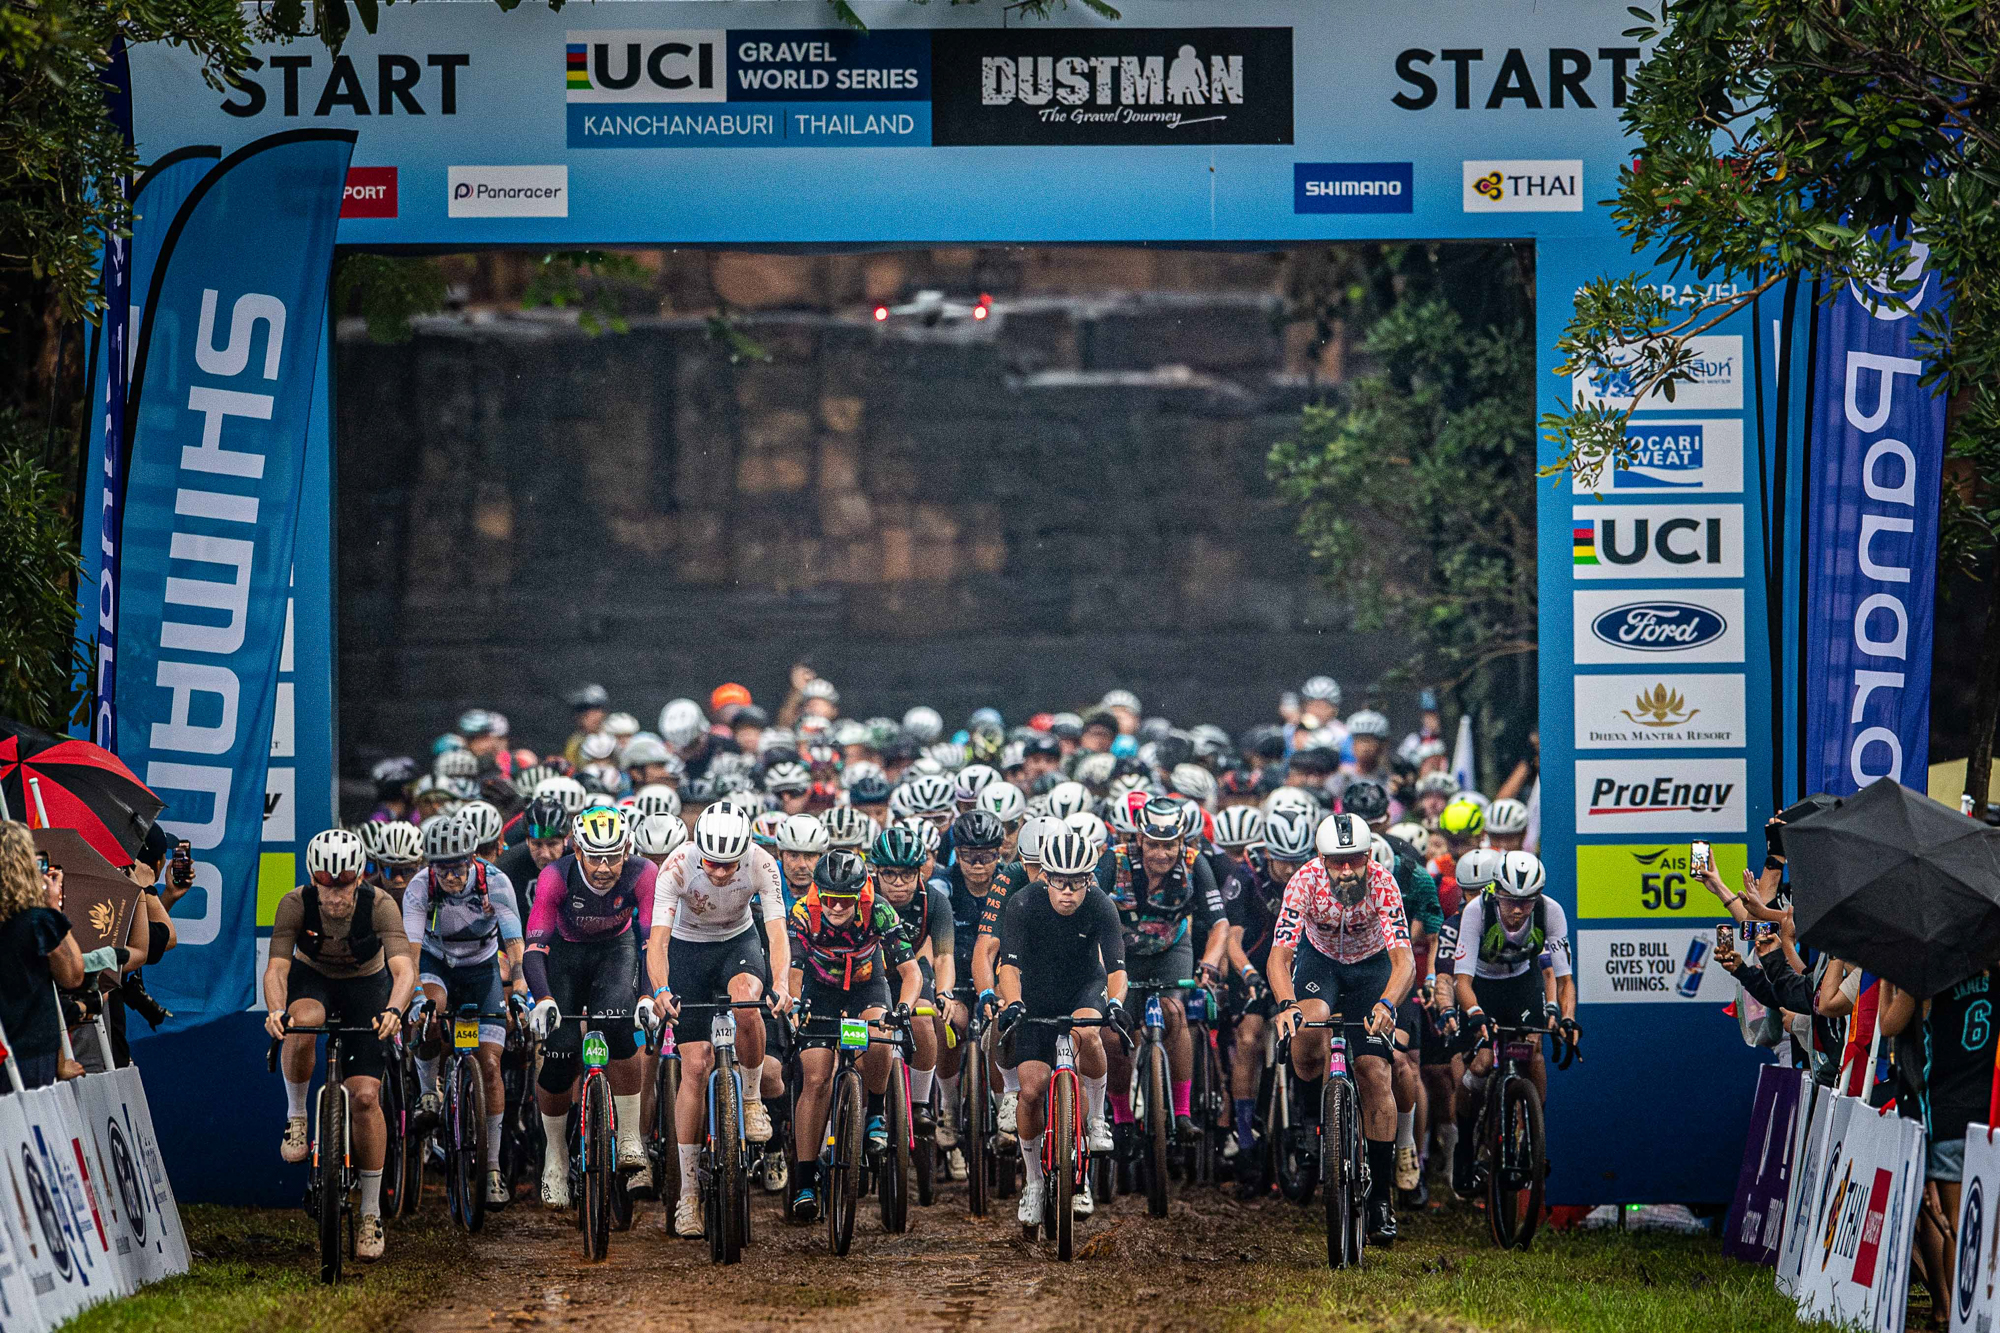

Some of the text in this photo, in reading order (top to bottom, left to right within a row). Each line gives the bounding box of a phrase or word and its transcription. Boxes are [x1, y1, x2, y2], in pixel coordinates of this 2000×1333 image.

[738, 42, 837, 63] GRAVEL
[594, 43, 713, 90] UCI
[220, 54, 470, 117] START
[737, 68, 918, 90] WORLD SERIES
[1391, 48, 1640, 110] START
[584, 115, 774, 136] KANCHANABURI
[795, 114, 914, 135] THAILAND
[1038, 106, 1182, 129] The Gravel Journey
[477, 183, 561, 200] Panaracer
[1305, 181, 1401, 196] SHIMANO
[1508, 176, 1575, 197] THAI
[1624, 435, 1700, 450] OCARI
[1624, 450, 1693, 465] WEAT
[1601, 518, 1721, 564] UCI
[146, 288, 287, 945] SHIMANO
[1618, 609, 1699, 643] Ford
[1631, 731, 1683, 741] MANTRA
[1687, 731, 1732, 740] RESORT
[1660, 857, 1687, 870] AIS
[1641, 872, 1687, 910] 5G
[1274, 907, 1300, 942] PAS
[1388, 907, 1409, 940] PAS
[1610, 942, 1669, 957] RED BULL
[1605, 959, 1675, 974] GIVES YOU
[1953, 976, 1990, 1000] JAMES
[456, 1030, 478, 1039] A546
[715, 1028, 732, 1038] A121
[843, 1030, 866, 1039] A436
[1961, 999, 1992, 1051] 6
[585, 1047, 606, 1057] A421
